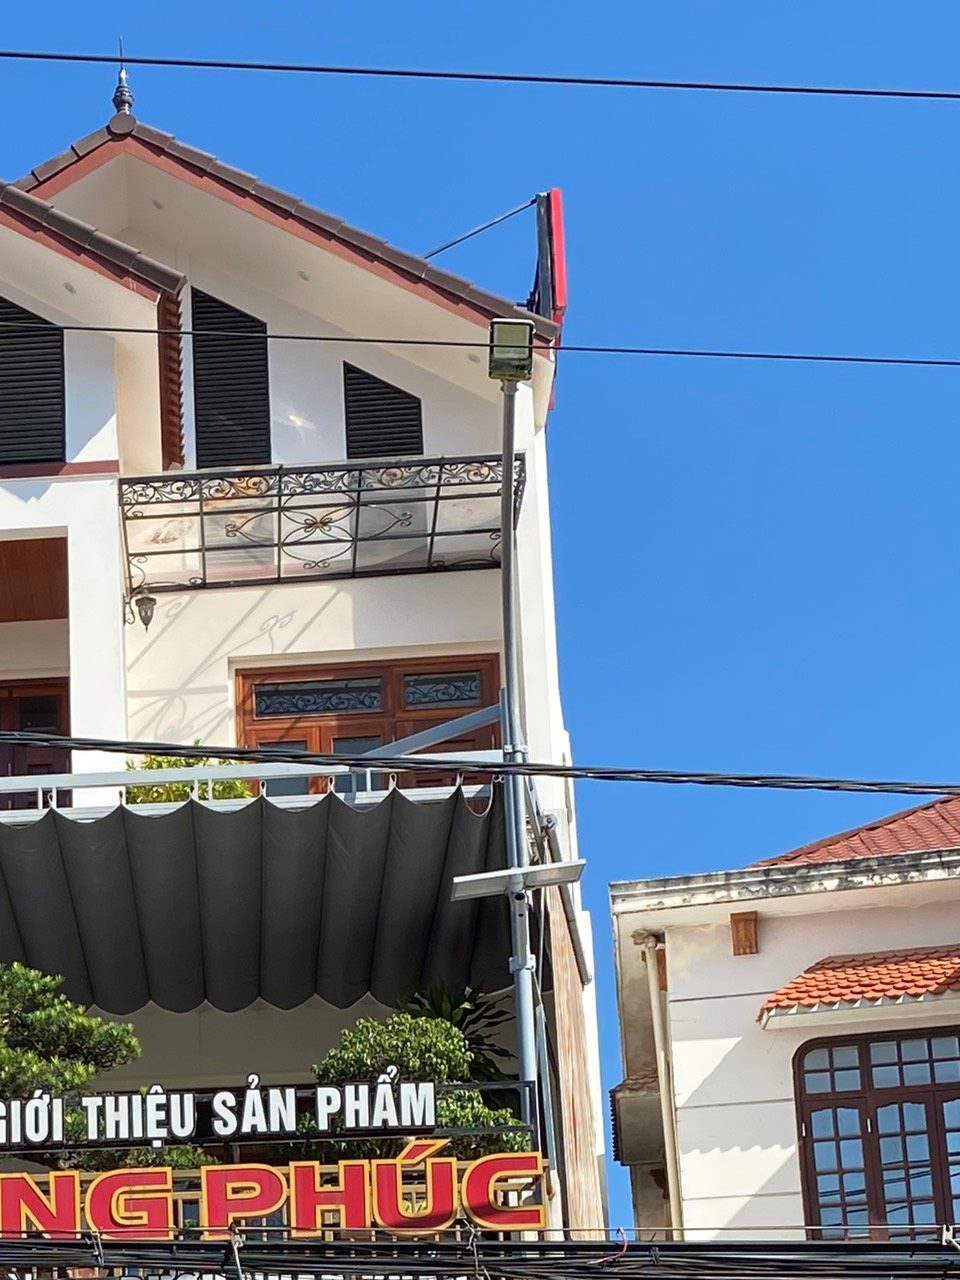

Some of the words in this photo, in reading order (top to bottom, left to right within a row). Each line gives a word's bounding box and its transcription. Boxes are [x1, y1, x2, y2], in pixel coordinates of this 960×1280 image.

[82, 1083, 194, 1148] THIỆU
[213, 1074, 296, 1136] SẢN
[316, 1065, 436, 1131] PHẨM
[201, 1139, 546, 1241] PHÚC
